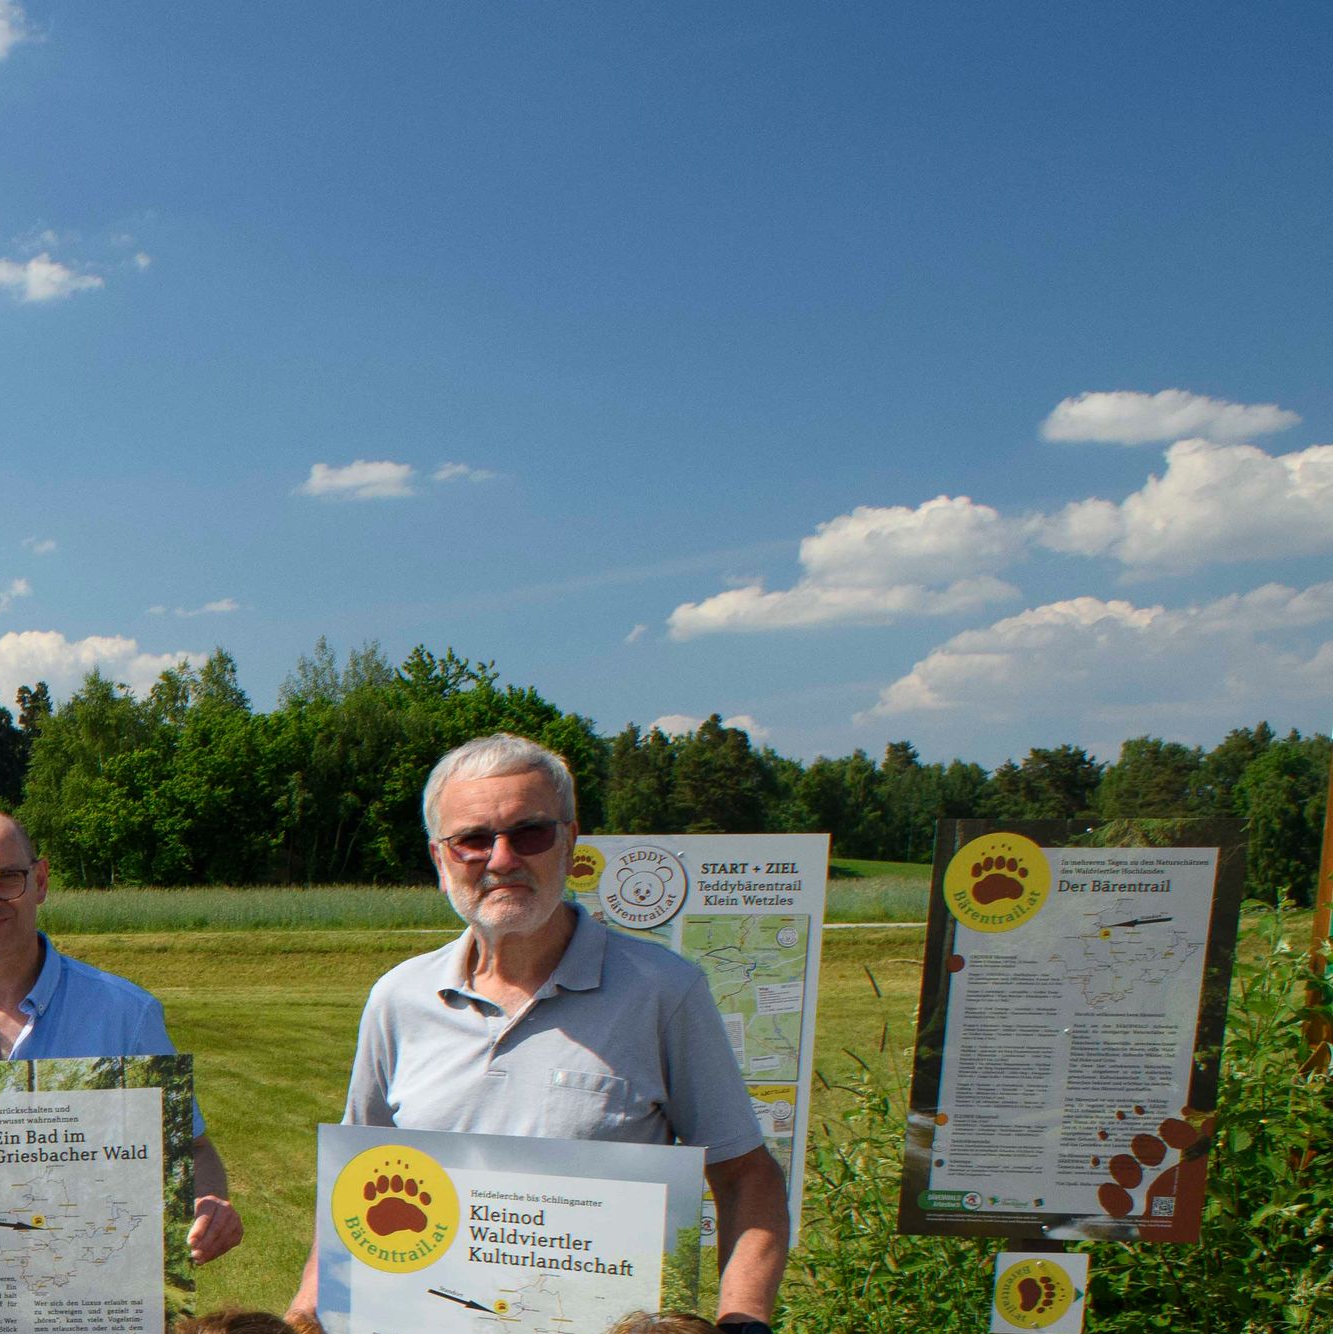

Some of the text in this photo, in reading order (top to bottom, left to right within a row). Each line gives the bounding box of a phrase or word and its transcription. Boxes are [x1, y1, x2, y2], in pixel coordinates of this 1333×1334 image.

[620, 850, 667, 866] TEDDY
[701, 863, 748, 874] START
[765, 862, 798, 873] ZIEL
[697, 880, 801, 893] Teddybärentrail
[1057, 879, 1170, 892] Der Bärentrail
[607, 893, 676, 922] Bärentrail.at
[704, 894, 793, 905] Klein Wetzles
[953, 889, 1041, 925] Bärentrail.at
[26, 1116, 78, 1124] wahrnehmen
[26, 1128, 58, 1143] Bad
[63, 1129, 85, 1142] im
[102, 1144, 147, 1159] Wald
[471, 1189, 602, 1206] Heidelerche bis Schlingnatter
[470, 1205, 544, 1225] Kleinod
[344, 1215, 449, 1263] Bärentrail.at
[469, 1226, 592, 1250] Waldviertler
[468, 1246, 633, 1276] Kulturlandschaft
